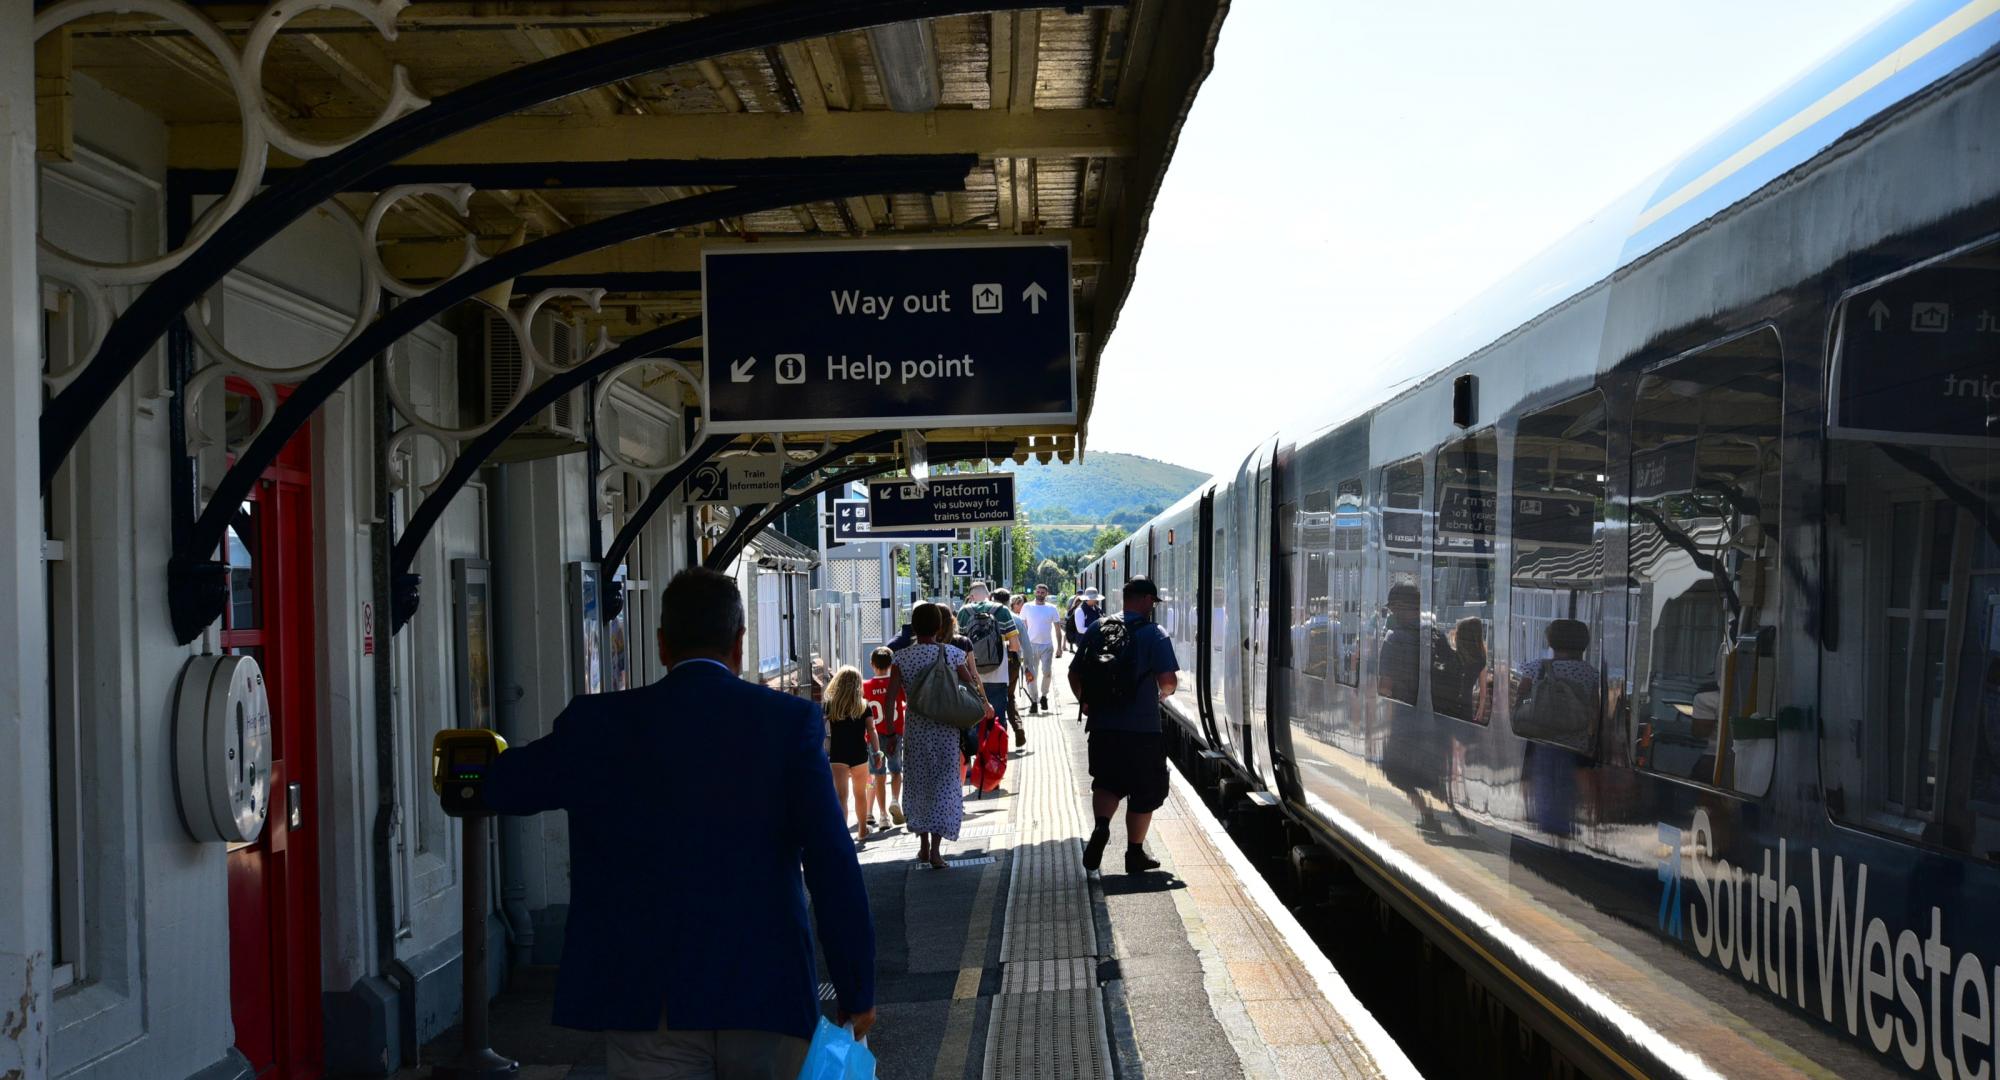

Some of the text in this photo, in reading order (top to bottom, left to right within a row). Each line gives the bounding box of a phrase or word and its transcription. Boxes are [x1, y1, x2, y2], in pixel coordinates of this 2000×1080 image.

[831, 290, 951, 320] Way out
[827, 354, 974, 385] Help point
[744, 470, 765, 478] Train
[729, 481, 780, 490] Information
[933, 483, 998, 497] Platform 1
[934, 498, 999, 510] via subway for
[934, 510, 1009, 521] trains to London
[958, 559, 968, 573] 2
[1690, 809, 1805, 1008] South
